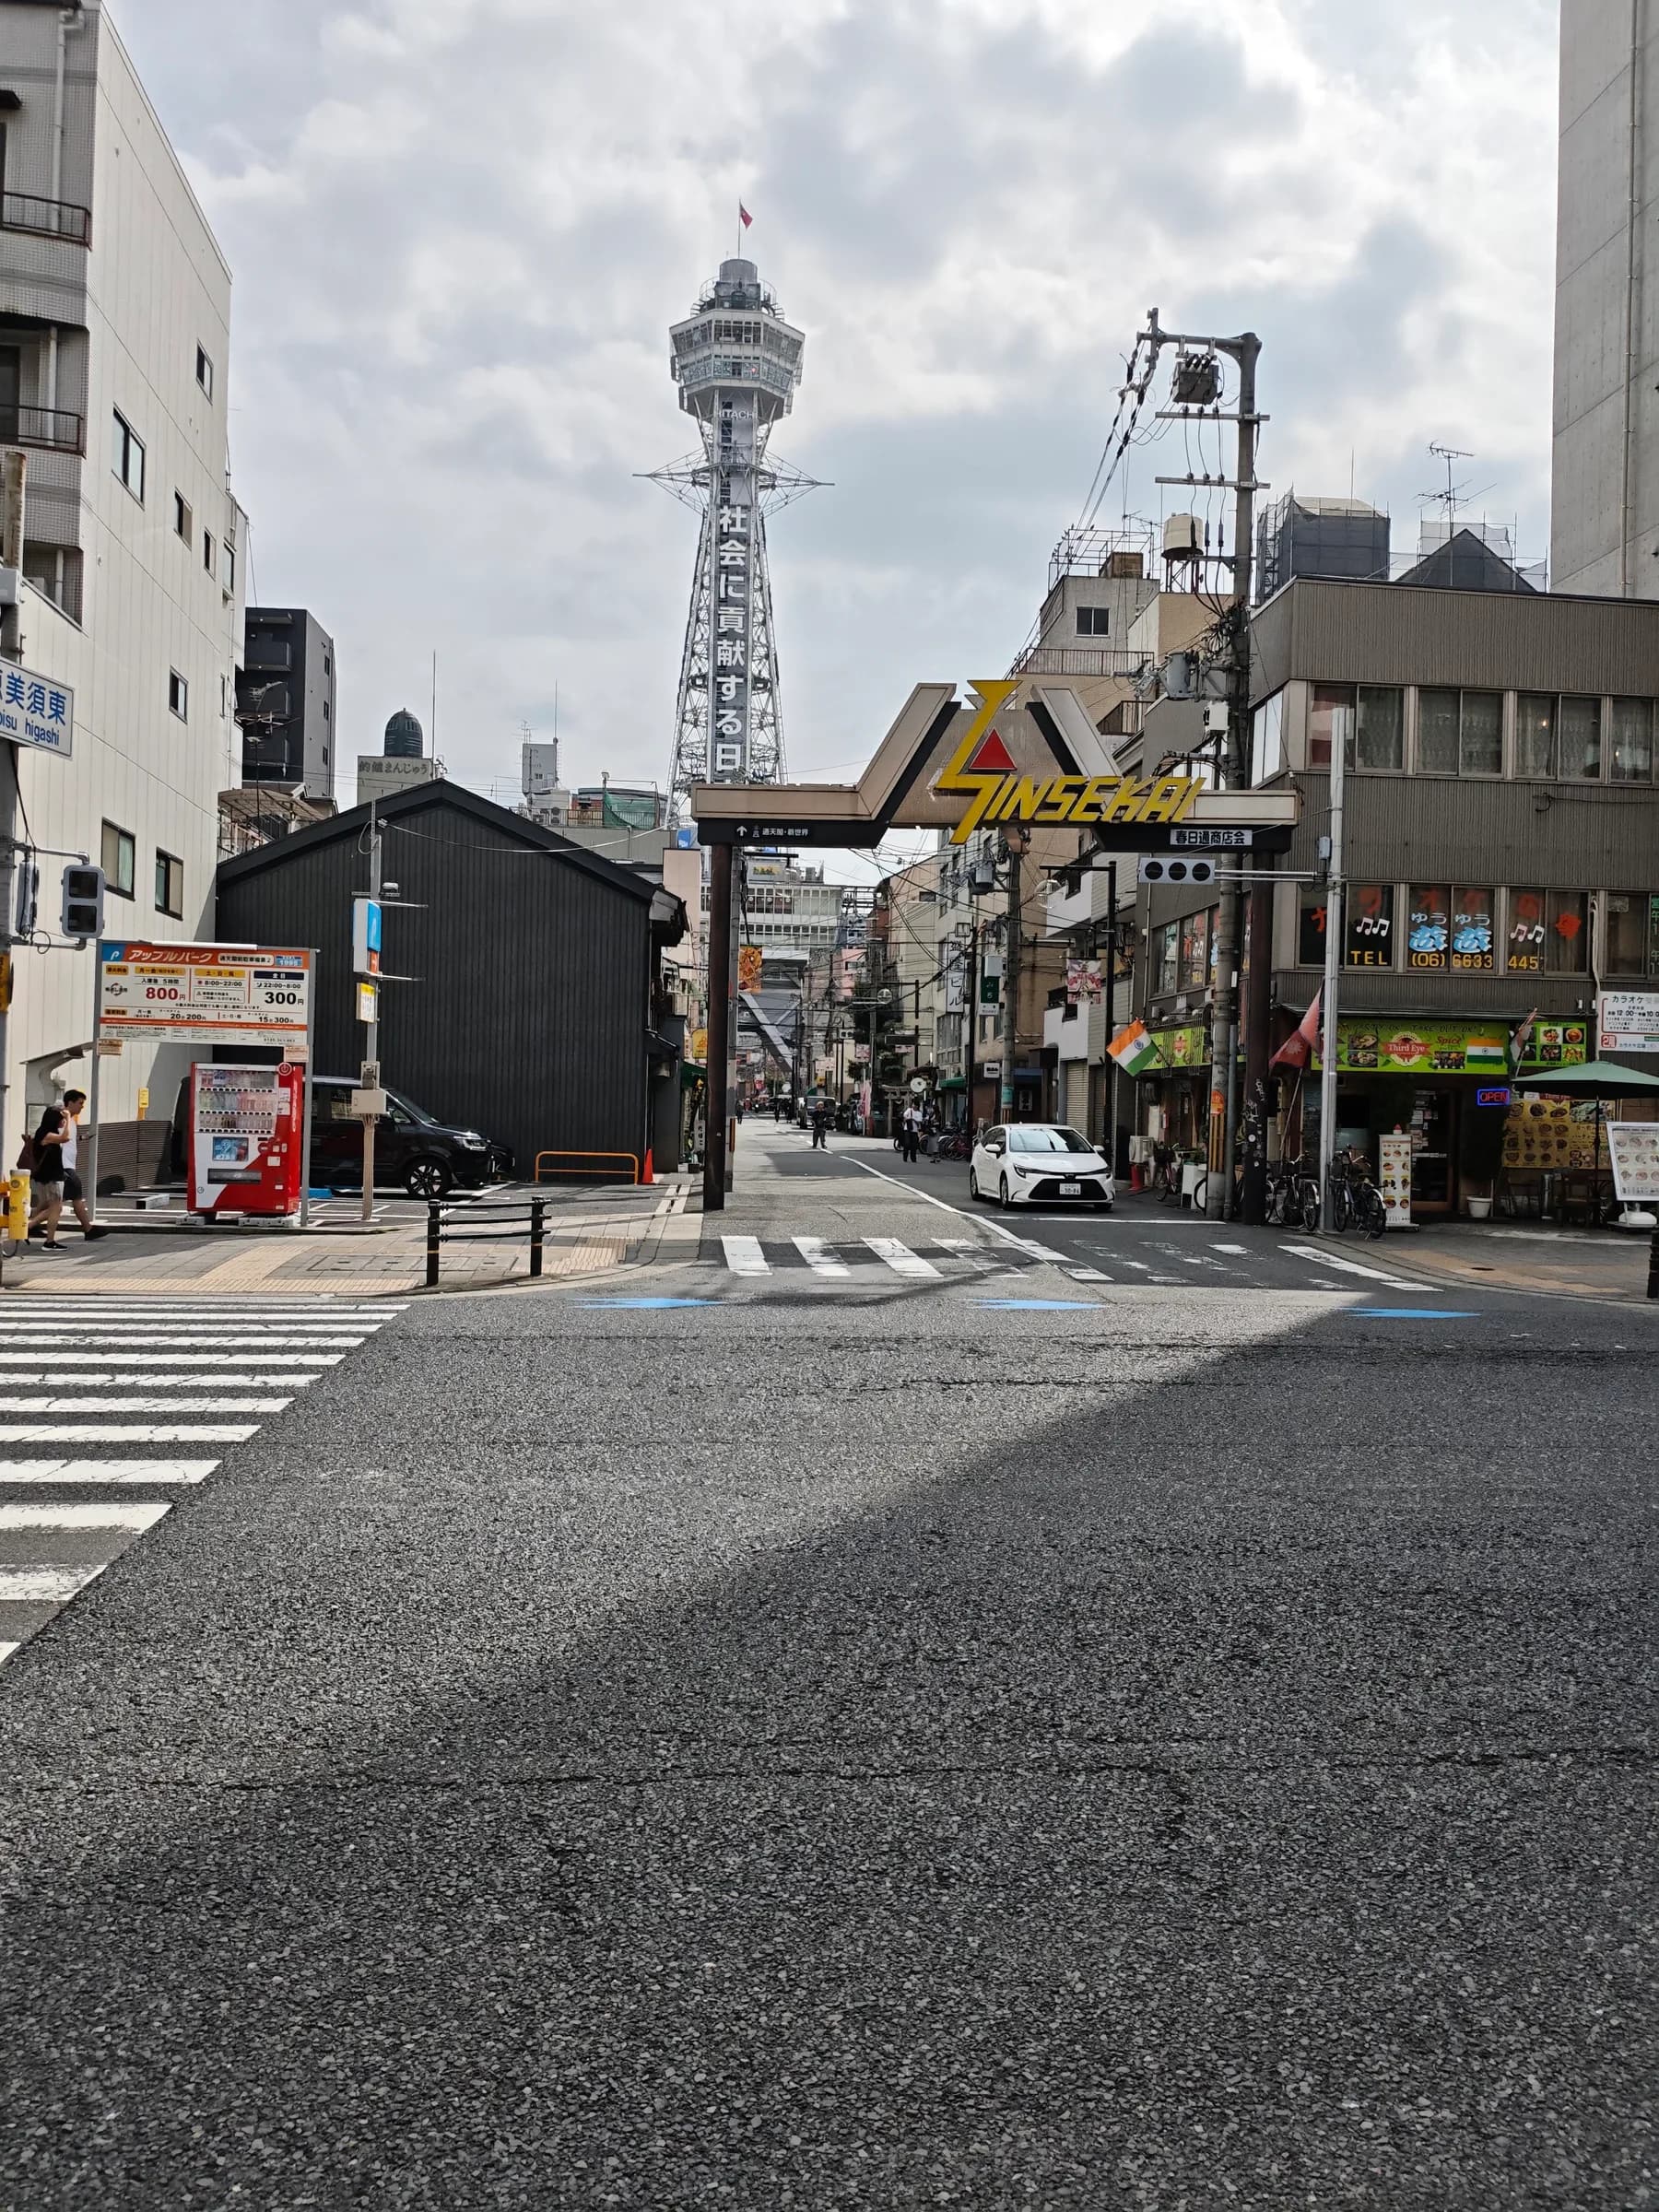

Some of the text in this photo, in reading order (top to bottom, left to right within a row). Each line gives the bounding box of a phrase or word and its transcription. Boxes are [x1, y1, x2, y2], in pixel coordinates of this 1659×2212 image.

[715, 505, 747, 783] 社会に貢献する日
[0, 669, 66, 726] 美須東
[25, 717, 60, 747] higashi
[935, 680, 1206, 844] SINSEKAI
[1175, 830, 1245, 844] 春日通商店会
[128, 949, 213, 963] アップルパーク
[1350, 950, 1545, 970] TEL (06) 6633 445
[146, 987, 186, 1001] 800円
[265, 991, 304, 1005] 300円
[1388, 1043, 1426, 1053] Third Eye
[1479, 1091, 1507, 1102] OPEN
